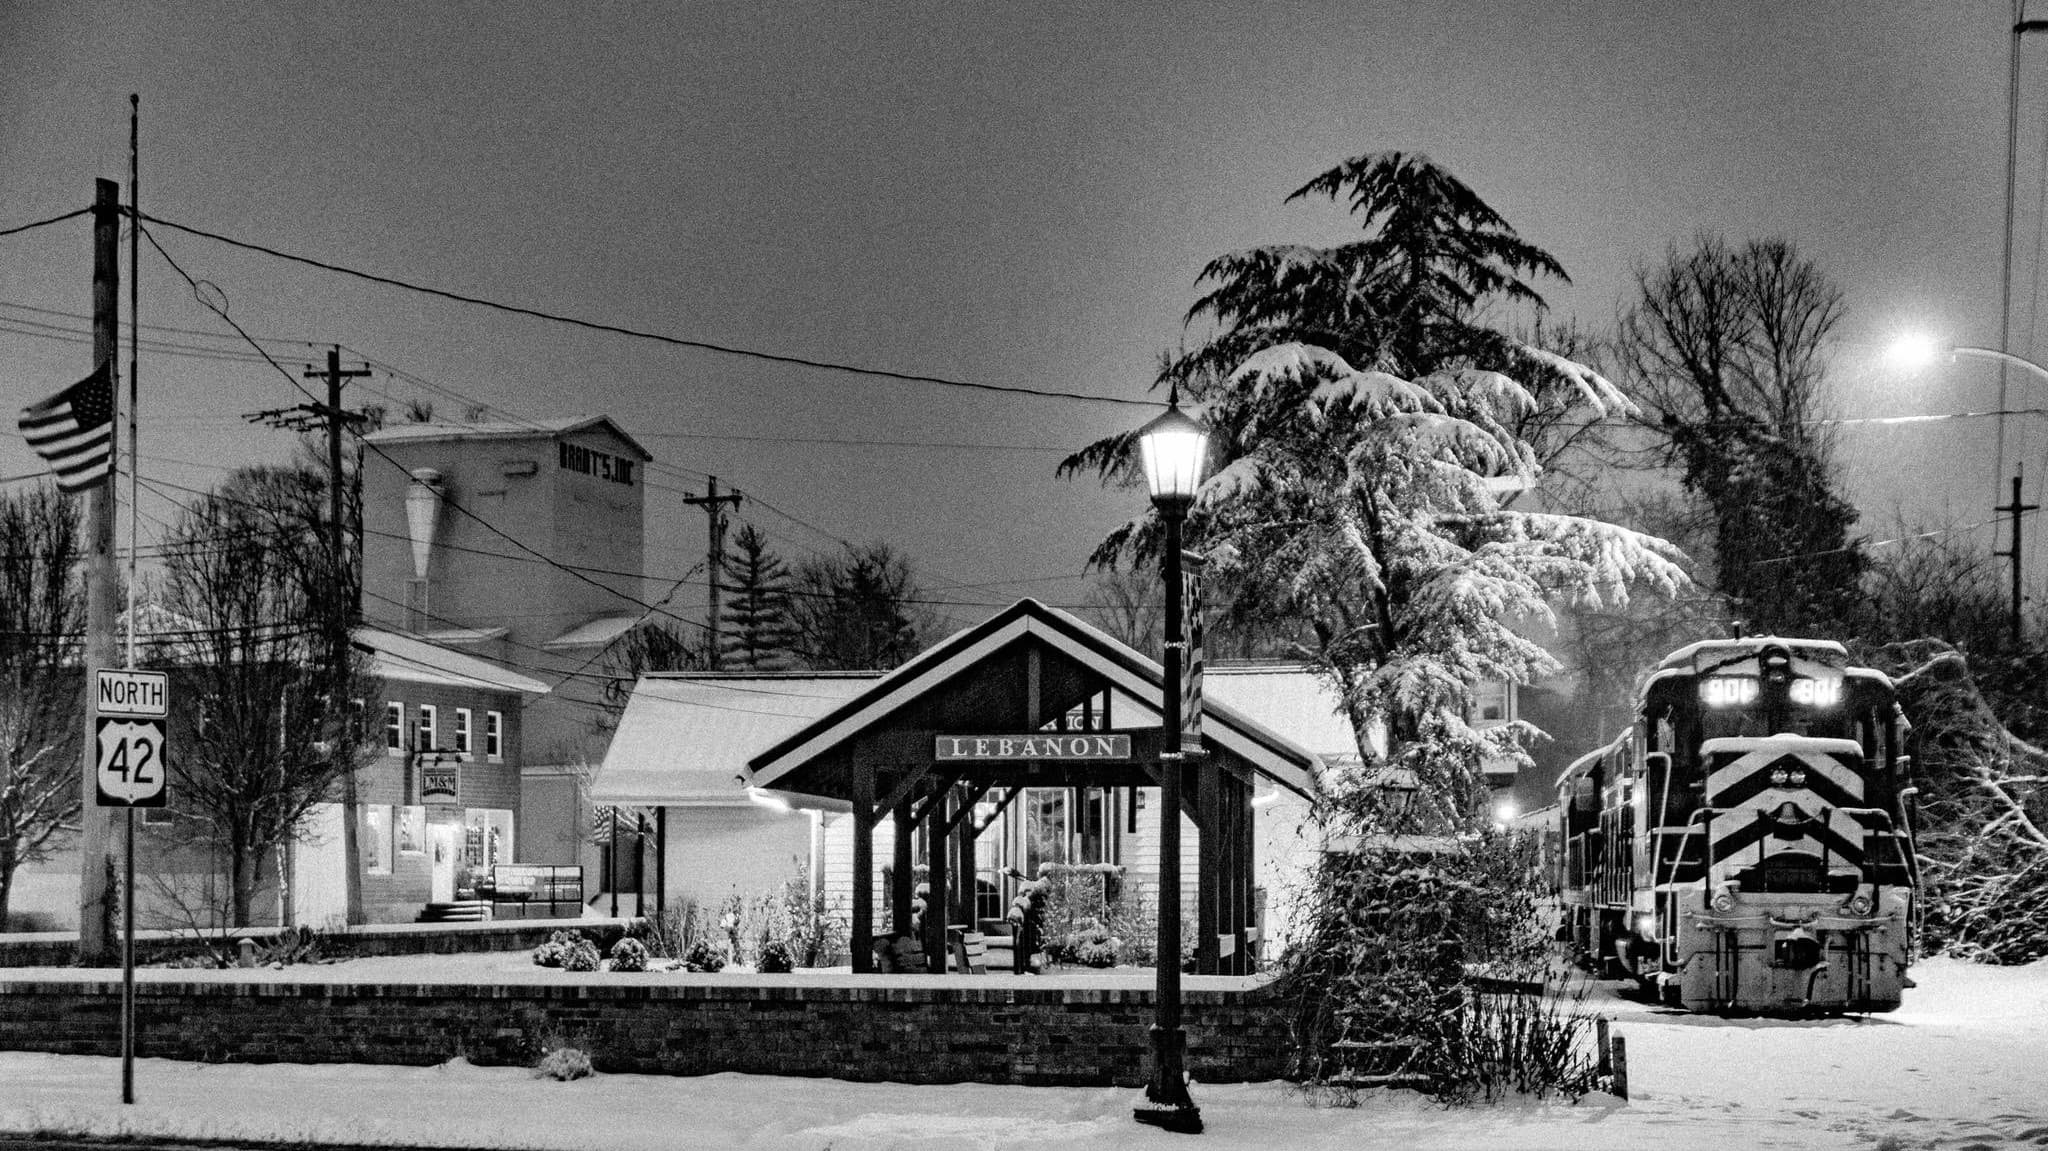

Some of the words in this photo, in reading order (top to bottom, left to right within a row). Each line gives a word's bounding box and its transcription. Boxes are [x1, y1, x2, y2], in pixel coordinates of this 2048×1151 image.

[100, 677, 163, 706] NORTH
[952, 737, 1115, 756] LEBANON
[107, 737, 154, 783] 42
[423, 776, 456, 790] LM&M
